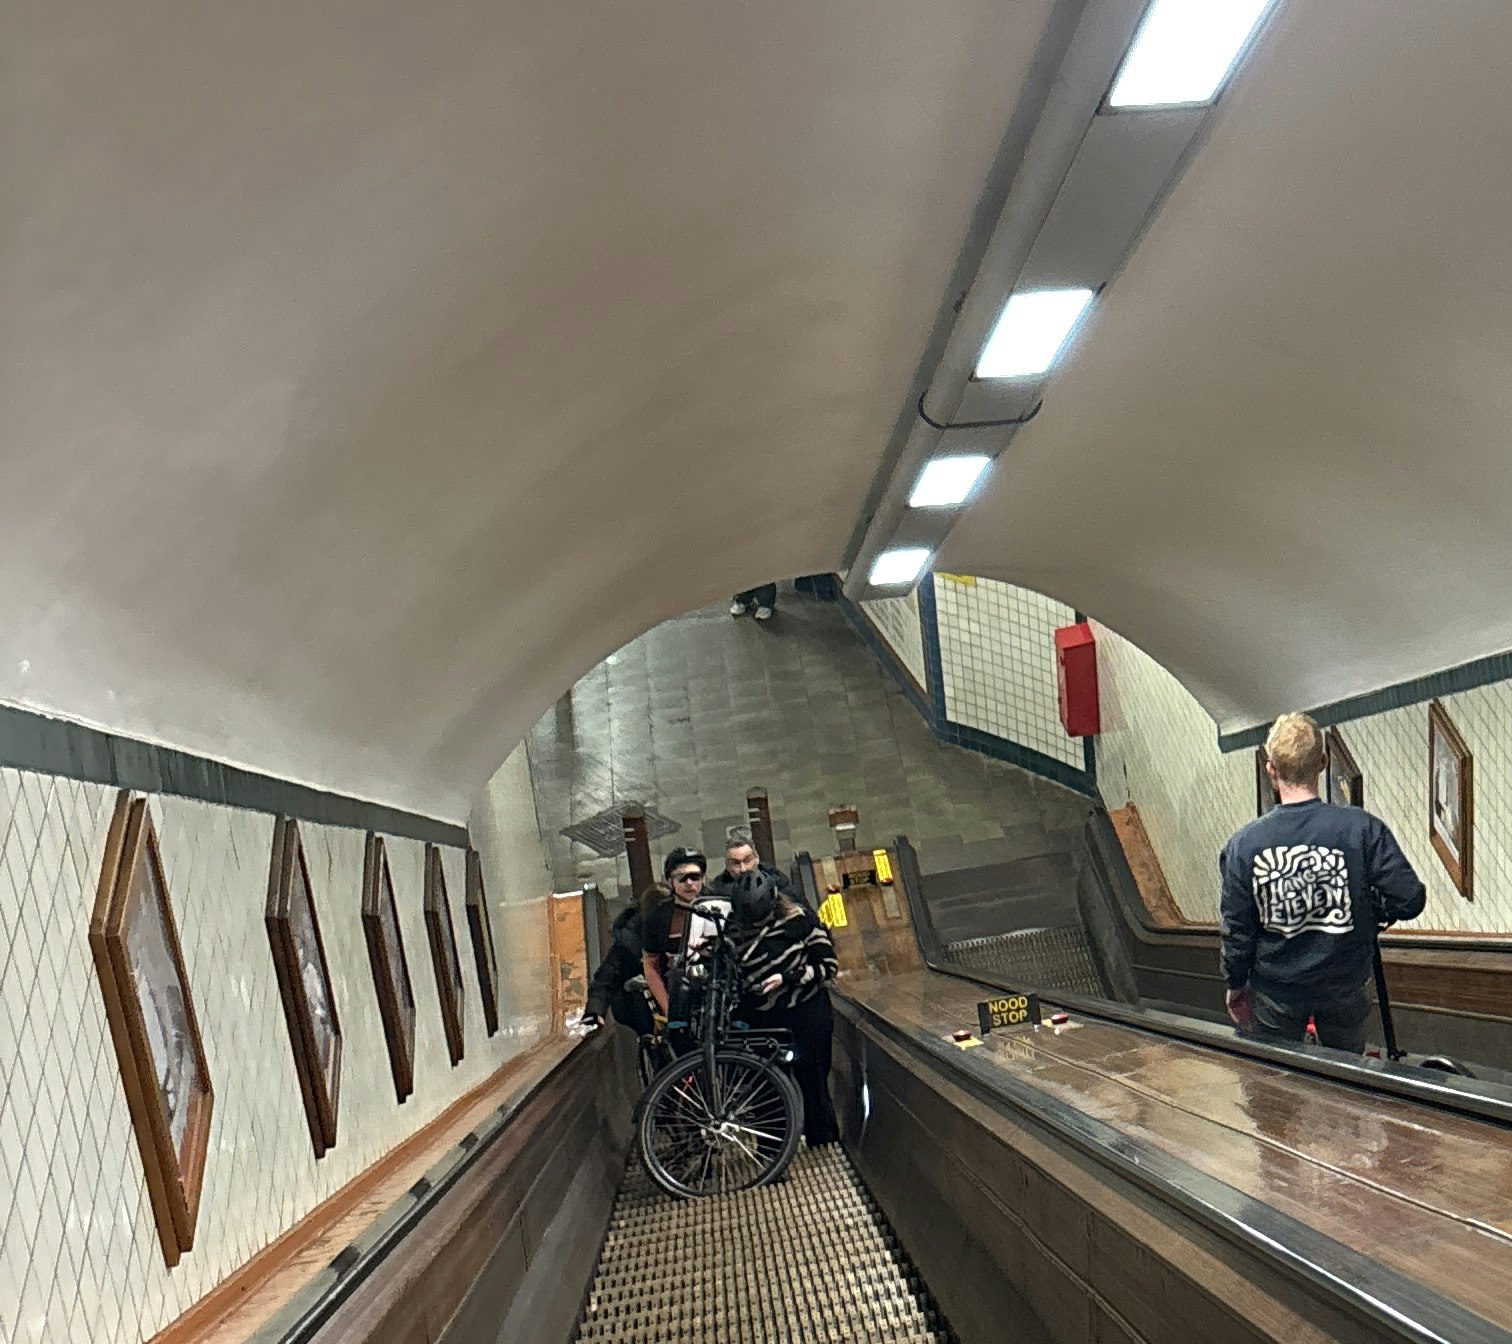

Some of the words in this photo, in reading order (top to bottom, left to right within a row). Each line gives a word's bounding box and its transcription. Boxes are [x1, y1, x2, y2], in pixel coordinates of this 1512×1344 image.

[1270, 869, 1317, 905] HANG
[1271, 883, 1343, 925] ELEVEN
[988, 996, 1028, 1014] NOOD
[992, 1009, 1028, 1027] STOP
